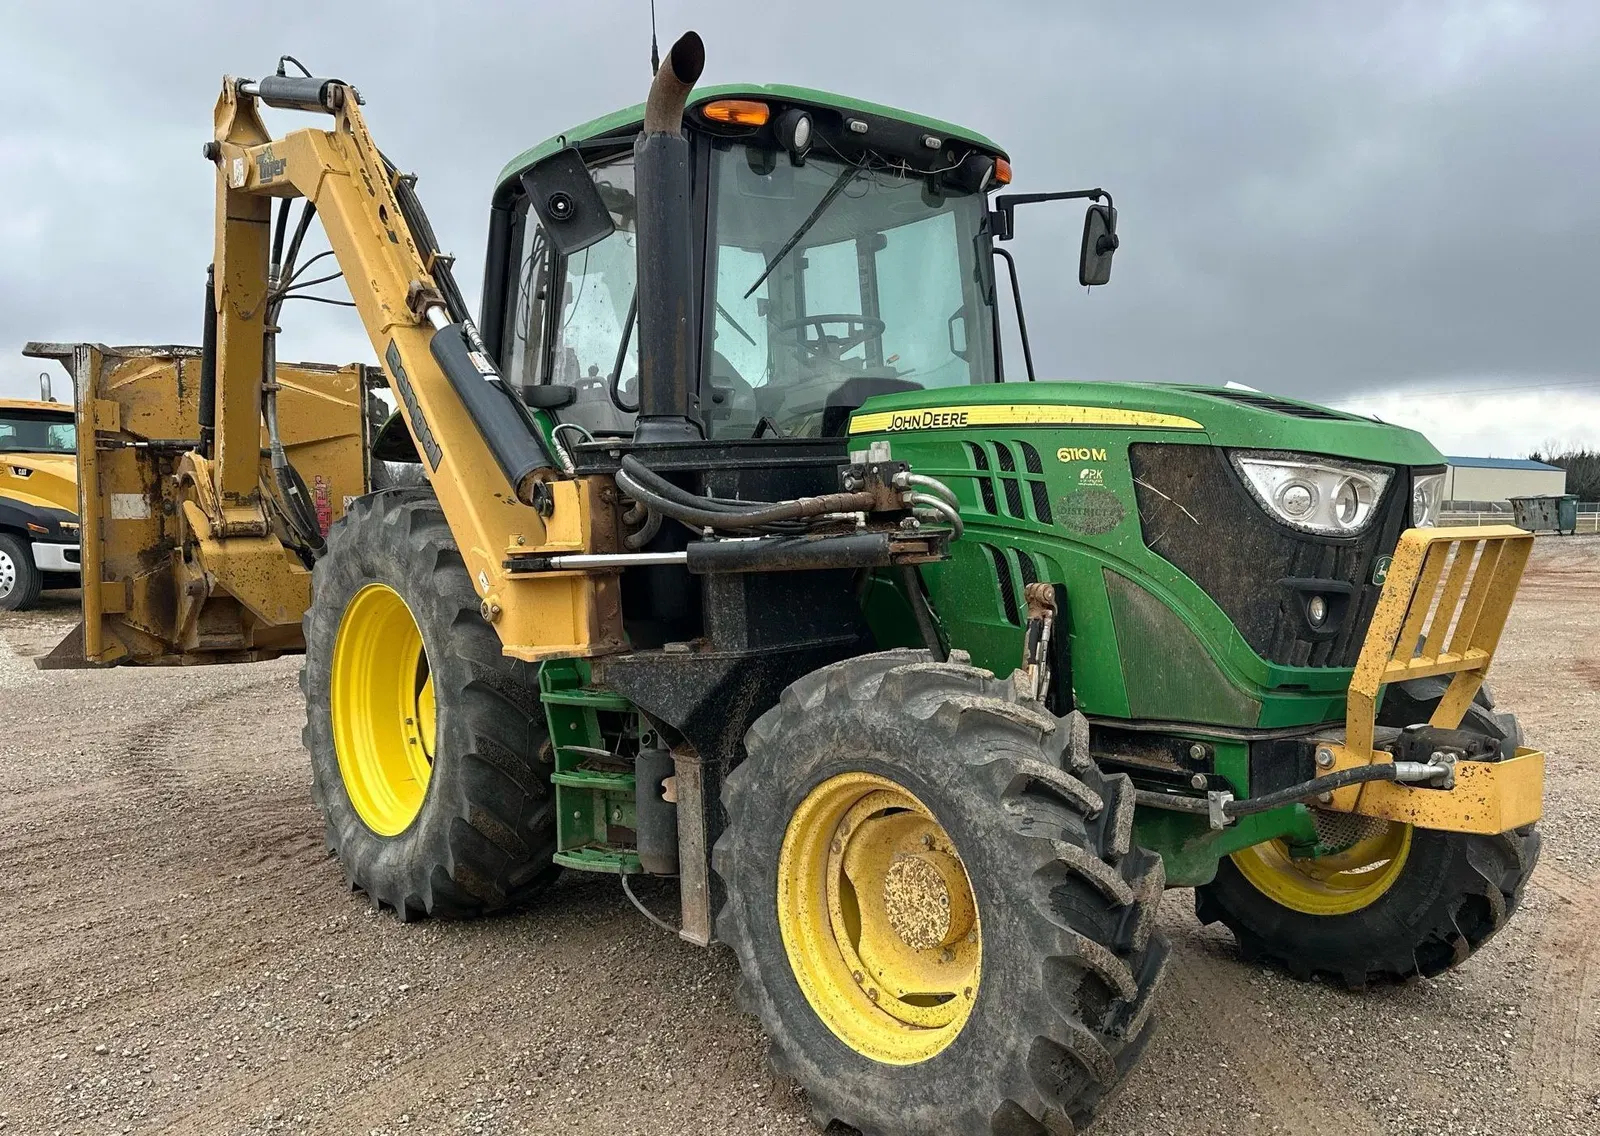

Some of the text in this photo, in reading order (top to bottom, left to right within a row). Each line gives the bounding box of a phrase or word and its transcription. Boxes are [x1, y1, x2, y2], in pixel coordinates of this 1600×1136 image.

[886, 411, 968, 431] JOHN DEERE
[17, 468, 28, 476] CAT
